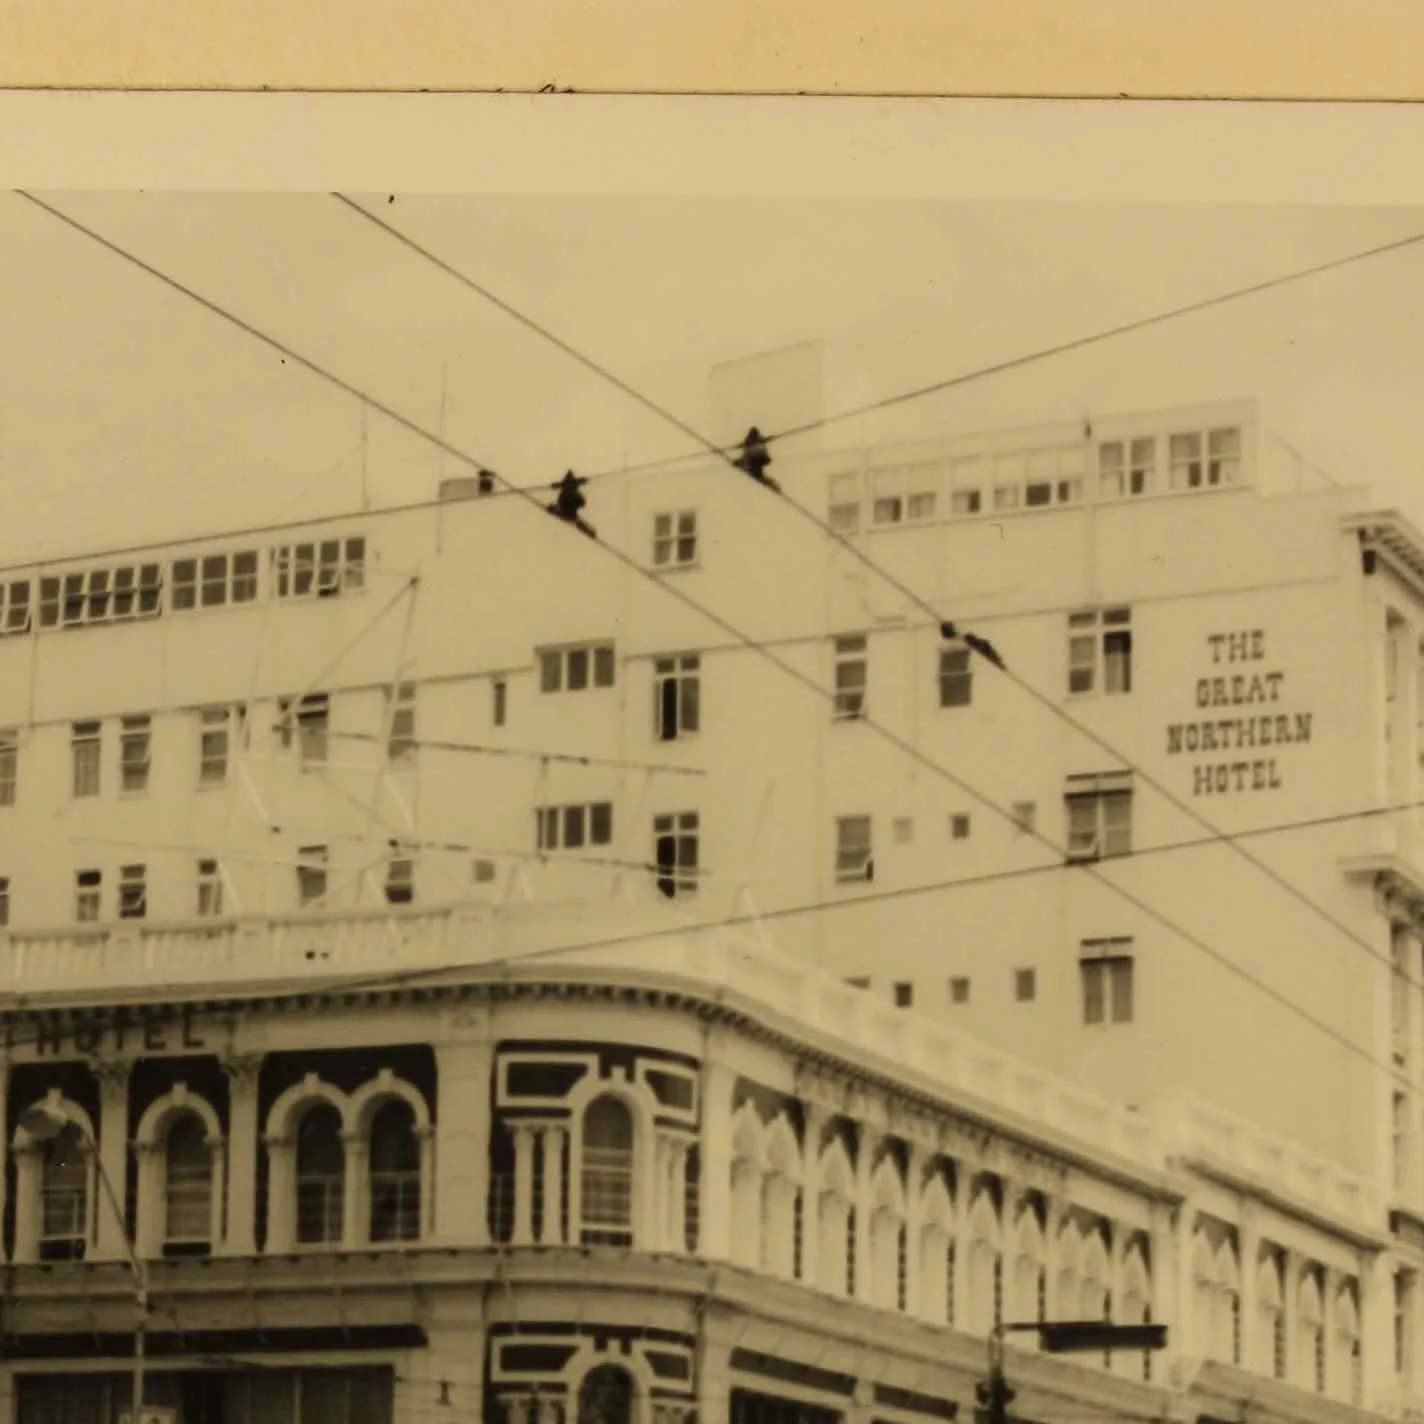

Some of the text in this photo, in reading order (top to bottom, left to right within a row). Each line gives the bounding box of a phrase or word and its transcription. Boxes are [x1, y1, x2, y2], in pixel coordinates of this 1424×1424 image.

[1207, 629, 1265, 663] THE
[1195, 672, 1285, 708] GREAT
[1166, 712, 1313, 754] NORTHERN
[1192, 759, 1282, 796] HOTEL
